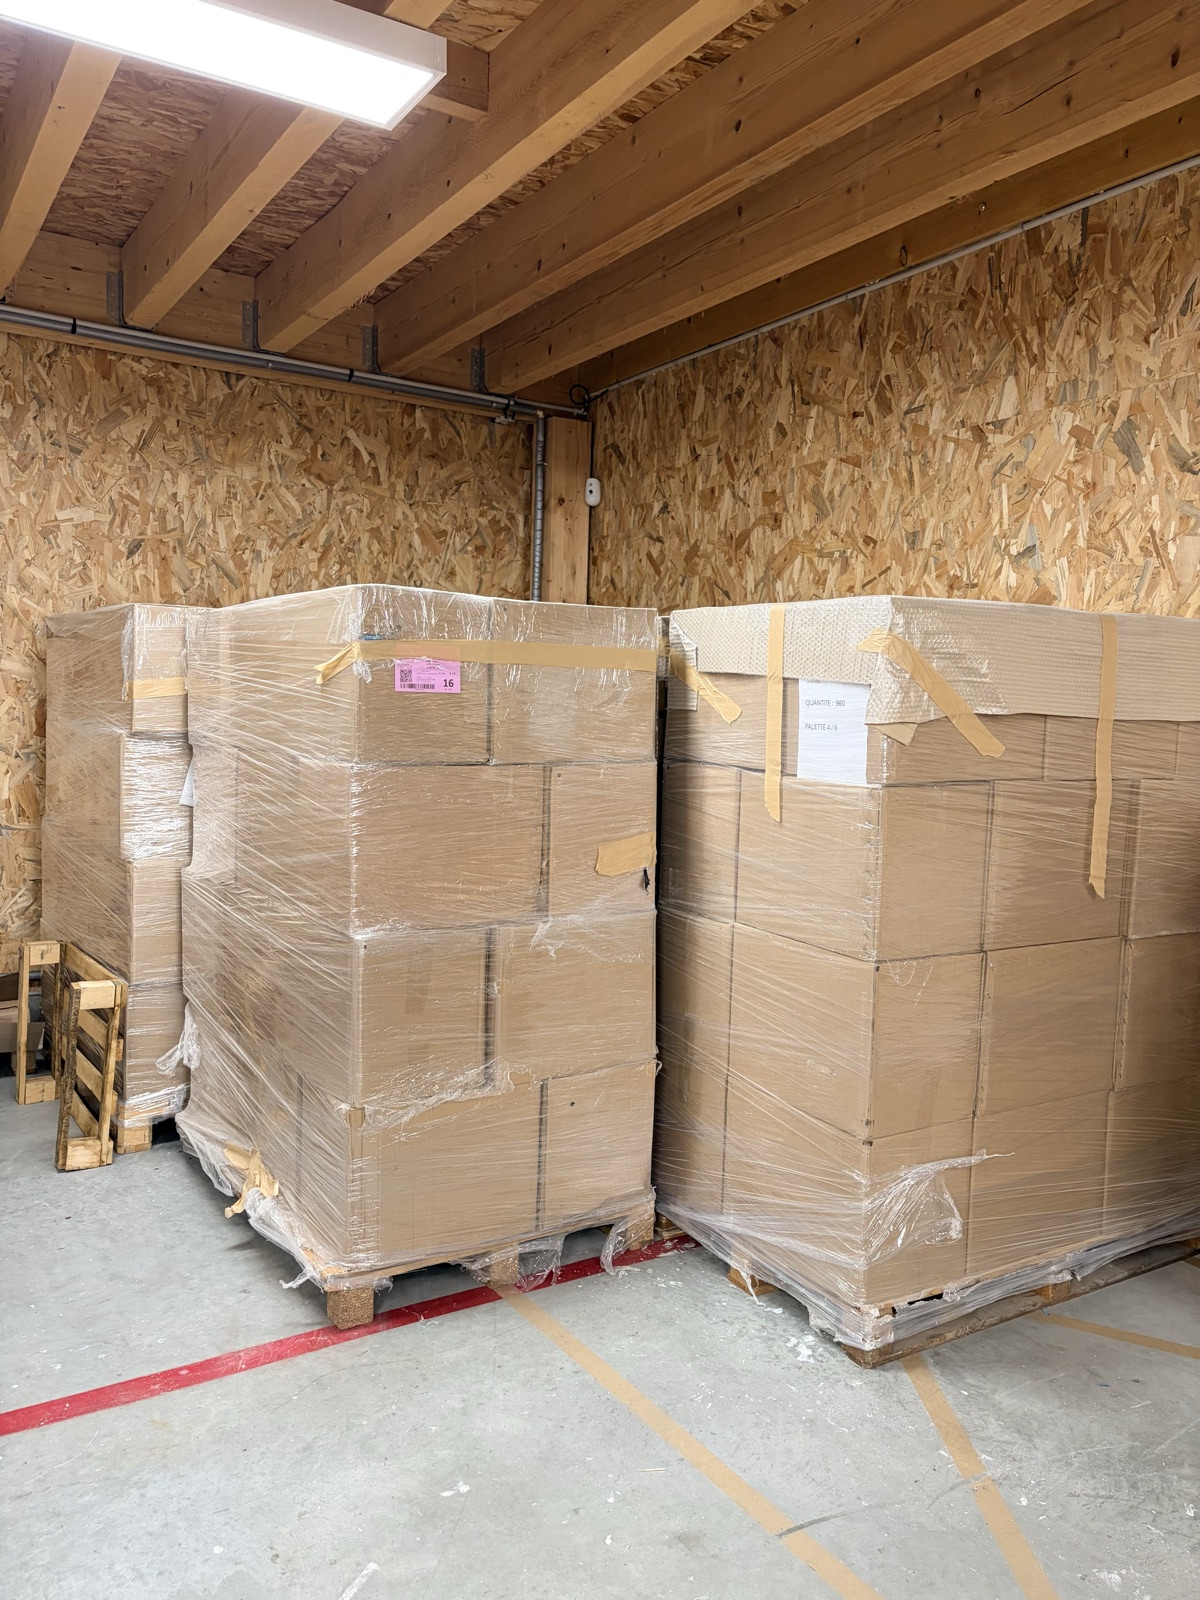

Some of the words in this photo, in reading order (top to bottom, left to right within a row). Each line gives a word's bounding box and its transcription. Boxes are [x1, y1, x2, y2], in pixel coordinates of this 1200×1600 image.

[443, 679, 454, 688] 16
[805, 699, 831, 707] QUANTITE
[835, 699, 846, 707] 960
[804, 723, 826, 731] PALETTE
